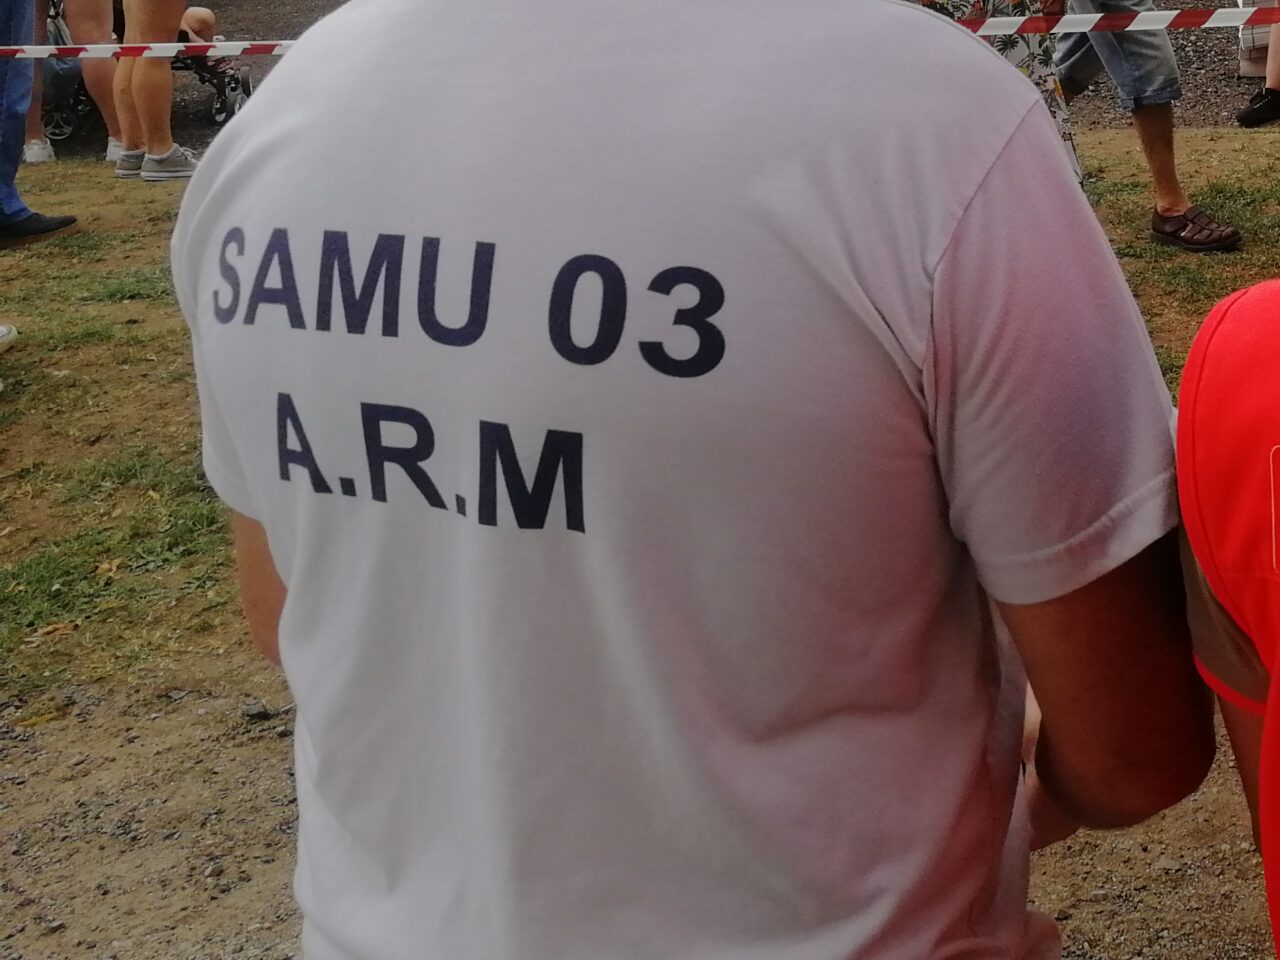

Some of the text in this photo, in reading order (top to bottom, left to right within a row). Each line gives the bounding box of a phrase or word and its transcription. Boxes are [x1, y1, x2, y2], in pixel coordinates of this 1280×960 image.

[213, 226, 726, 379] SAMU 03
[276, 391, 586, 533] A.R.M
